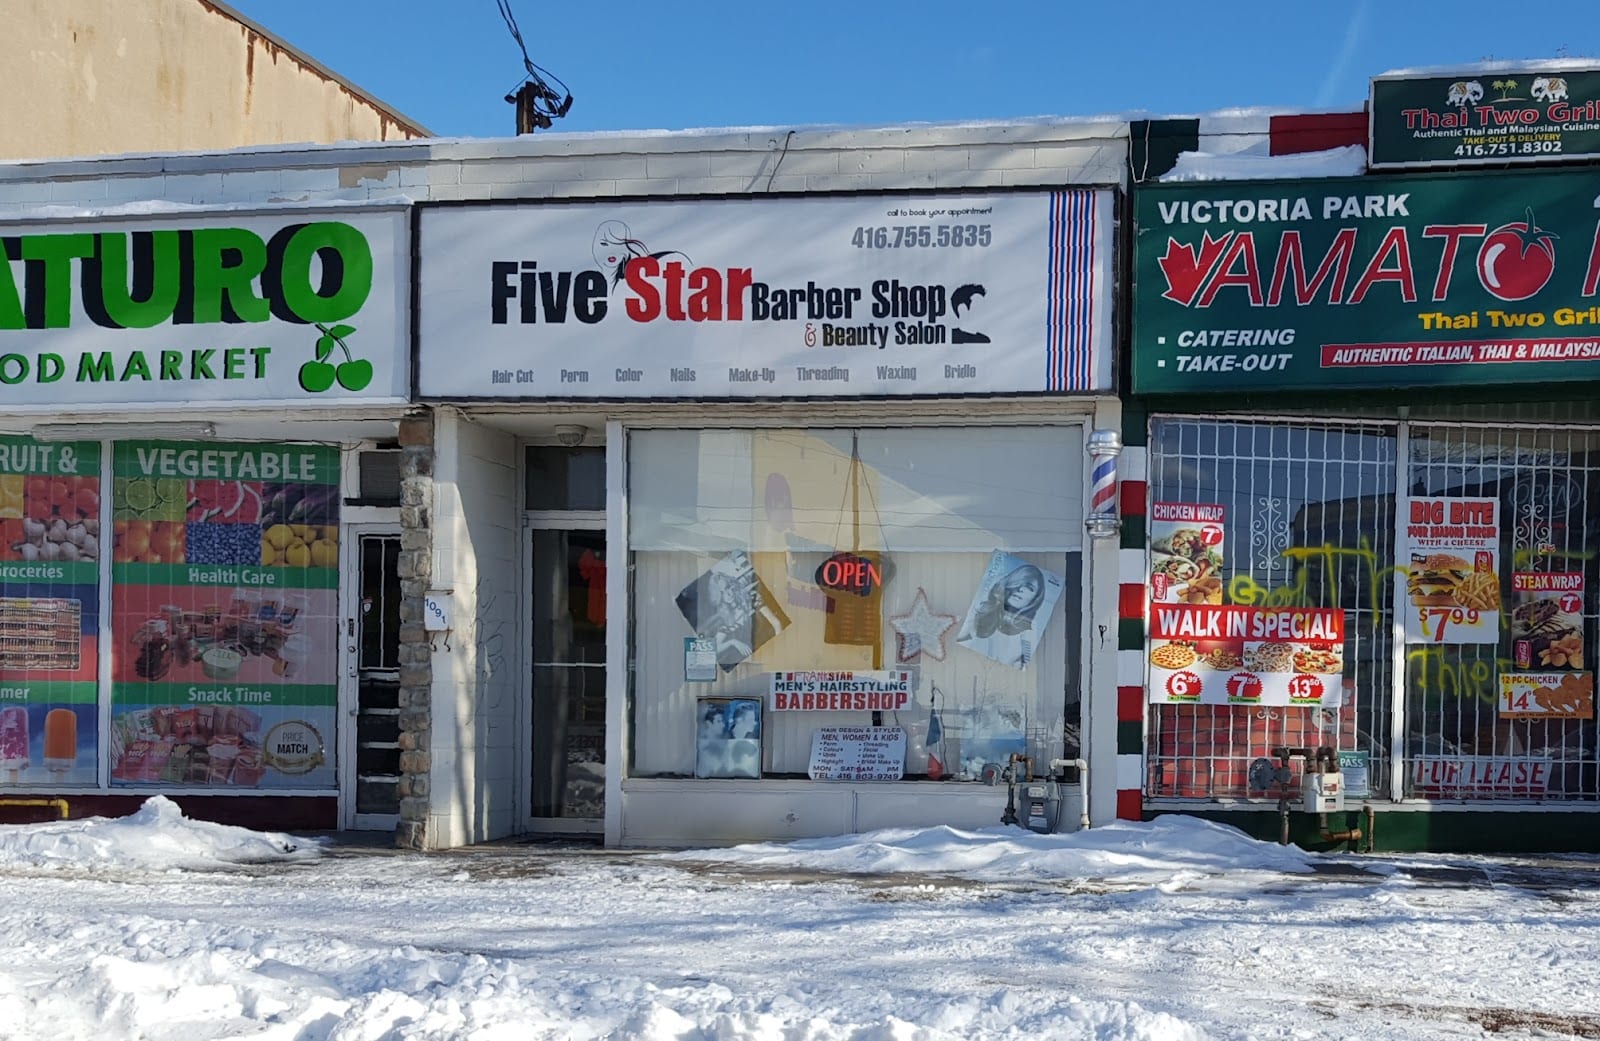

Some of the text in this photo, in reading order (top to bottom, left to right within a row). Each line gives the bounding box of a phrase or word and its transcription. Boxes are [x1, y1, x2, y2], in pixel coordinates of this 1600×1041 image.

[1401, 106, 1468, 129] Thai
[1474, 105, 1539, 126] Two
[1413, 121, 1600, 138] Authentic Thai and Malaysian Cuisine
[1463, 133, 1562, 144] TAKE-OUT & DELIVERY
[1454, 141, 1562, 156] 416.751.8302
[909, 208, 926, 216] book
[929, 209, 946, 218] your
[947, 206, 992, 218] appointment
[1157, 193, 1411, 225] VICTORIA PARK
[851, 224, 992, 249] 416.755.5835
[492, 256, 946, 324] Five Star Barber Shop
[1418, 311, 1478, 330] Thai
[1485, 310, 1545, 328] Two
[804, 321, 946, 349] & Beauty Salon
[1176, 327, 1296, 348] CATERING
[1332, 347, 1412, 363] AUTHENTIC
[1415, 345, 1474, 363] ITALIAN,
[1478, 344, 1513, 359] THAI
[1515, 344, 1526, 358] &
[76, 347, 272, 382] MARKET
[1174, 353, 1293, 372] TAKE-OUT
[492, 369, 534, 384] Hair Cut
[561, 369, 589, 383] Perm
[615, 367, 643, 382] Color
[670, 367, 696, 382] Nails
[729, 367, 775, 383] Make-Up
[797, 366, 849, 381] Threading
[877, 365, 917, 381] Waxing
[944, 364, 976, 379] Bridle
[58, 446, 78, 474] &
[137, 447, 316, 481] VEGETABLE
[1154, 504, 1224, 520] CHICKEN WRAP
[1410, 500, 1494, 525] BIG BITE
[0, 562, 64, 578] roceries
[188, 568, 275, 584] Health Care
[823, 560, 882, 587] OPEN
[1514, 575, 1581, 589] STEAK WRAP
[1158, 608, 1338, 640] WALK IN SPECIAL
[690, 642, 713, 651] PASS
[775, 682, 907, 692] MEN'S HAIRSTYLING
[1501, 675, 1558, 684] 12 PC CHICKEN
[188, 687, 272, 703] Snack Time
[775, 692, 908, 710] BARBERSHOP
[282, 731, 304, 742] PRICE
[821, 734, 839, 742] MEN,
[276, 743, 309, 754] MATCH
[1340, 758, 1364, 768] PASS
[1469, 761, 1545, 785] LEASE
